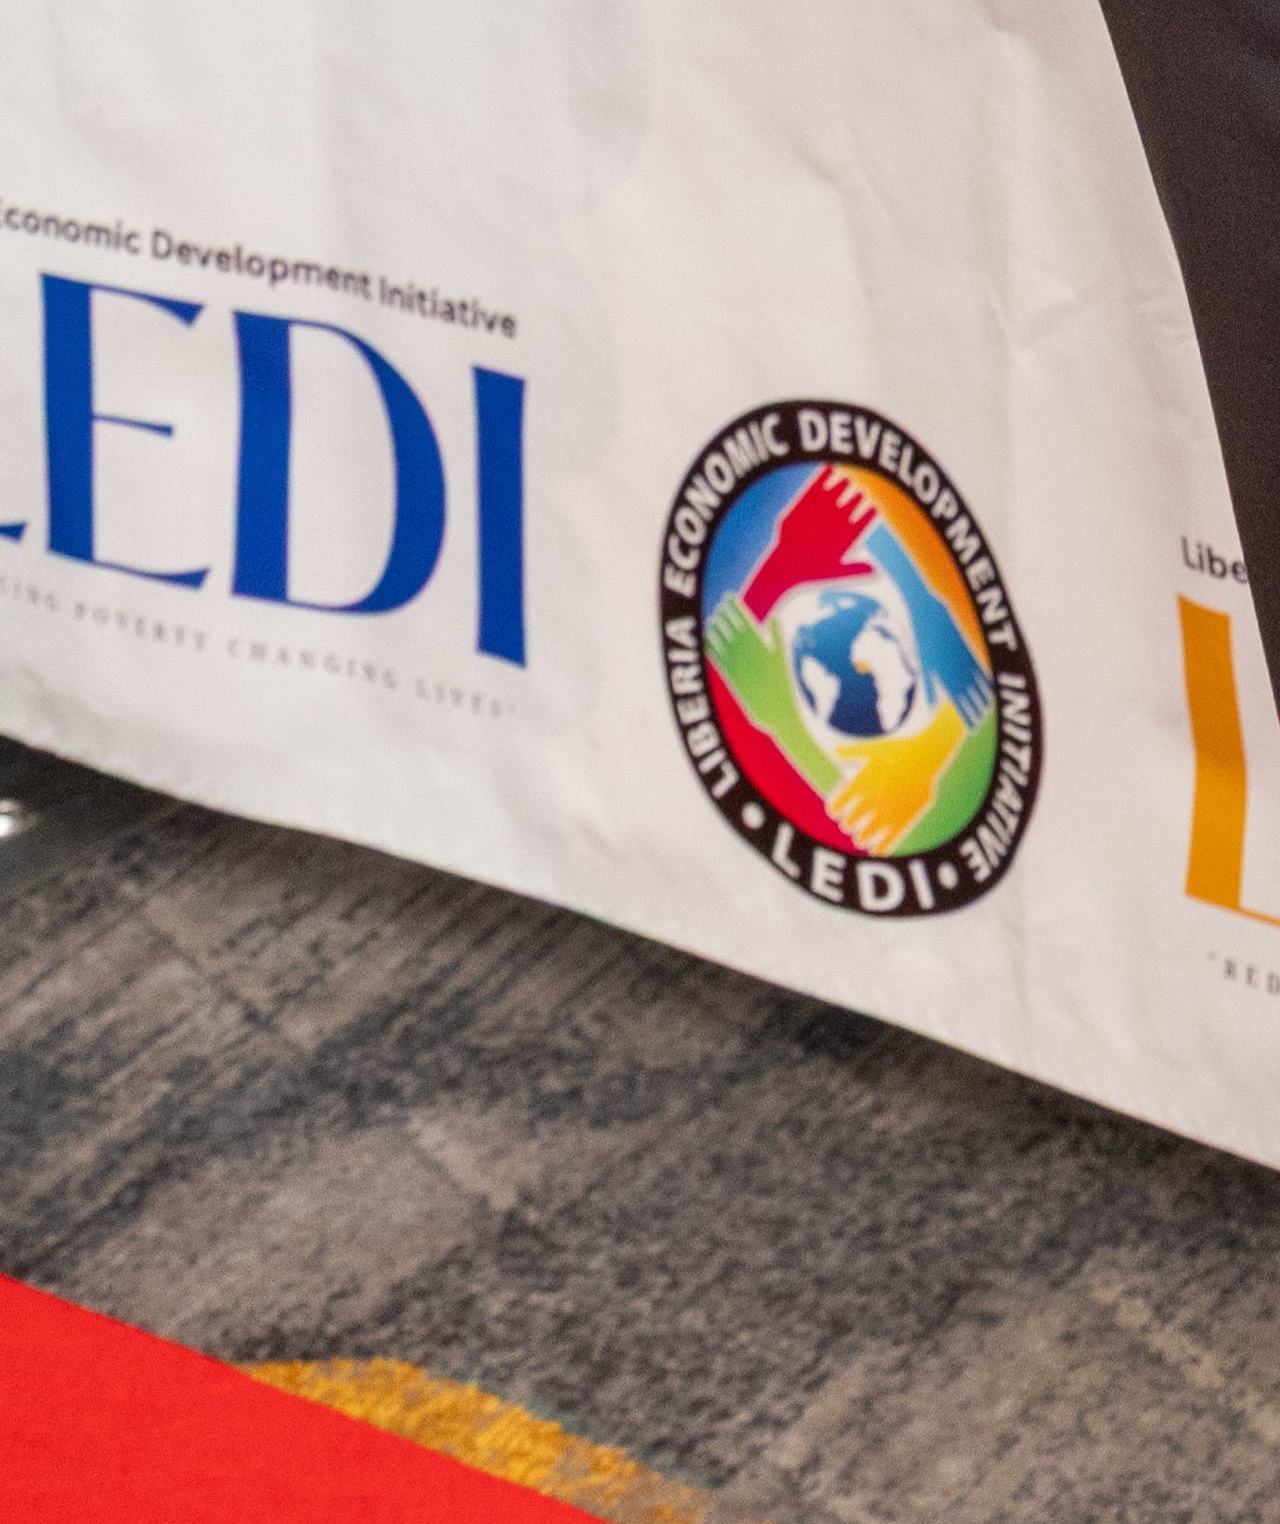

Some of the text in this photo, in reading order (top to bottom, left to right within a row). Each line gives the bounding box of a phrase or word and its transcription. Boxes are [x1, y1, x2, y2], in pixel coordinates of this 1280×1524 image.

[151, 230, 370, 296] Development
[378, 277, 517, 338] Initiative
[0, 273, 526, 669] EDI
[666, 413, 789, 597] ECONOMIC
[800, 408, 1014, 650] DEVELOPMENT
[667, 619, 739, 800] LIBERIA
[961, 672, 1032, 881] INITIATIVE
[770, 823, 934, 911] LEDI
